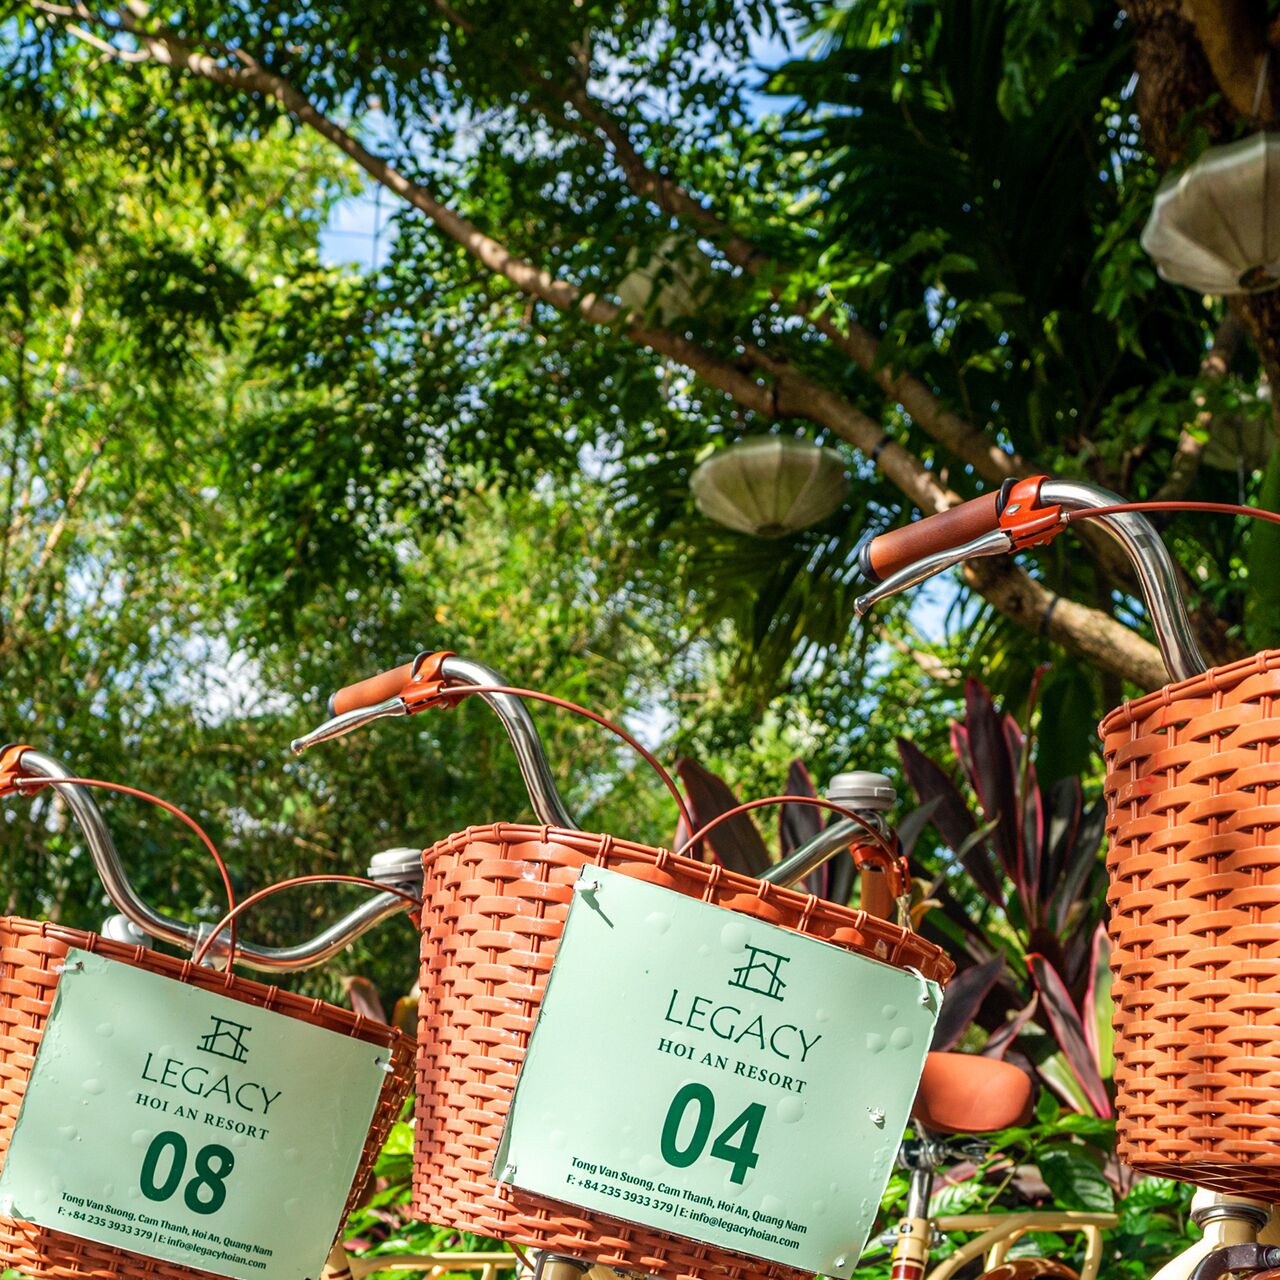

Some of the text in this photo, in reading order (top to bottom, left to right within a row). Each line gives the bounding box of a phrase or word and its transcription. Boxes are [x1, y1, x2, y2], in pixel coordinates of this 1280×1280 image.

[664, 988, 822, 1063] LEGACY
[141, 1052, 282, 1115] LEGACY
[657, 1037, 807, 1094] HOI AN RESORT
[135, 1093, 270, 1140] HOI AN RESORT
[660, 1082, 767, 1186] 04
[139, 1130, 235, 1215] 08
[571, 1156, 808, 1234] Tong Van Suong, Cam Thanh, Hoi An, Quang Nam
[57, 1206, 66, 1216] F:
[67, 1210, 87, 1222] +84
[86, 1214, 107, 1227] 235
[107, 1220, 133, 1235] 3933
[133, 1227, 153, 1240] 379
[157, 1234, 167, 1244] E:
[166, 1236, 267, 1270] info@legacyhoian.com
[62, 1192, 273, 1257] Tong Van Suong, Cam Thanh, Hoi An, Quang Nam
[566, 1173, 576, 1185] F:
[577, 1179, 599, 1192] +84
[599, 1183, 622, 1198] 235
[622, 1190, 651, 1207] 3933
[651, 1199, 674, 1213] 379
[679, 1207, 689, 1218] E:
[689, 1209, 800, 1250] info@legacyhoian.com
